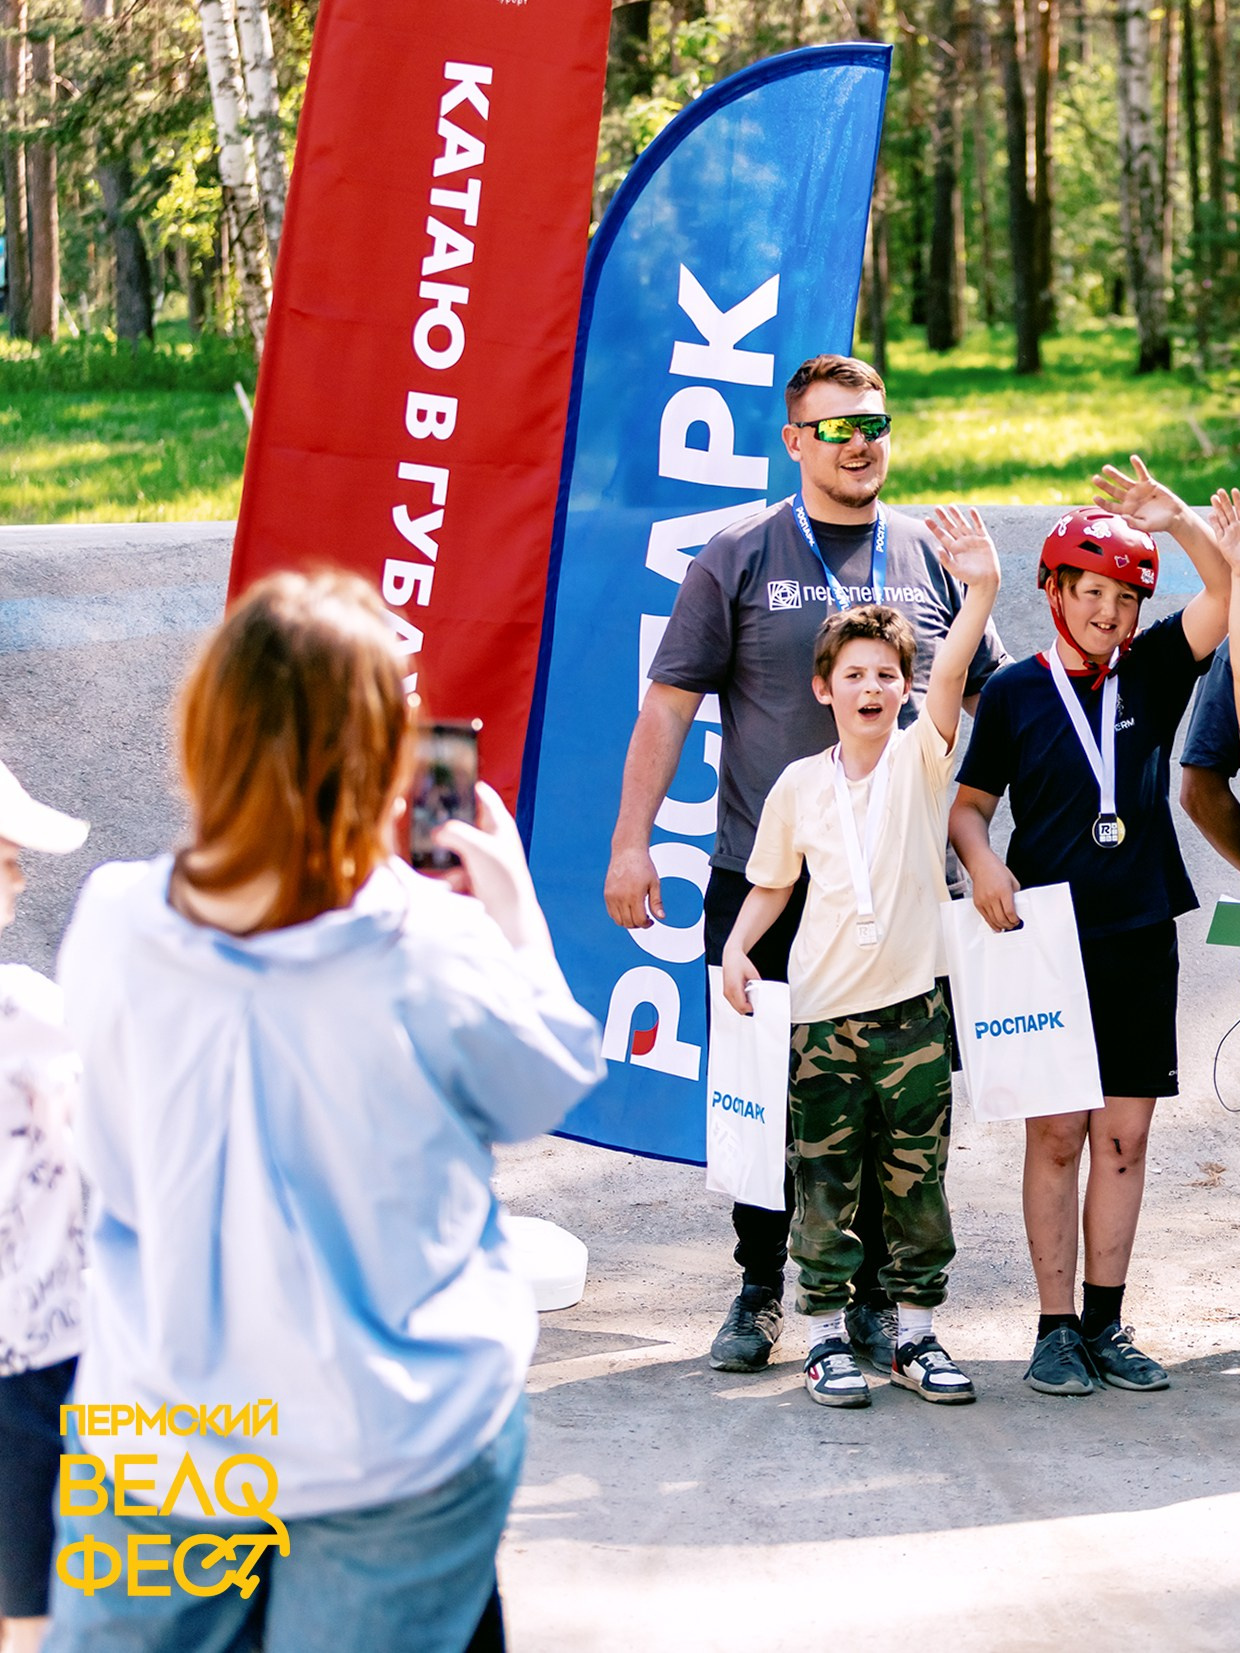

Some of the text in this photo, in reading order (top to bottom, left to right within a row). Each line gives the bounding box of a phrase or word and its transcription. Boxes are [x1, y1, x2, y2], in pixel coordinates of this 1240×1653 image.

[382, 60, 494, 694] КАТАЮ В ГУБА
[795, 506, 815, 547] РОСПАРК
[803, 585, 927, 606] перспетива
[975, 1011, 1065, 1039] РОСПАРК
